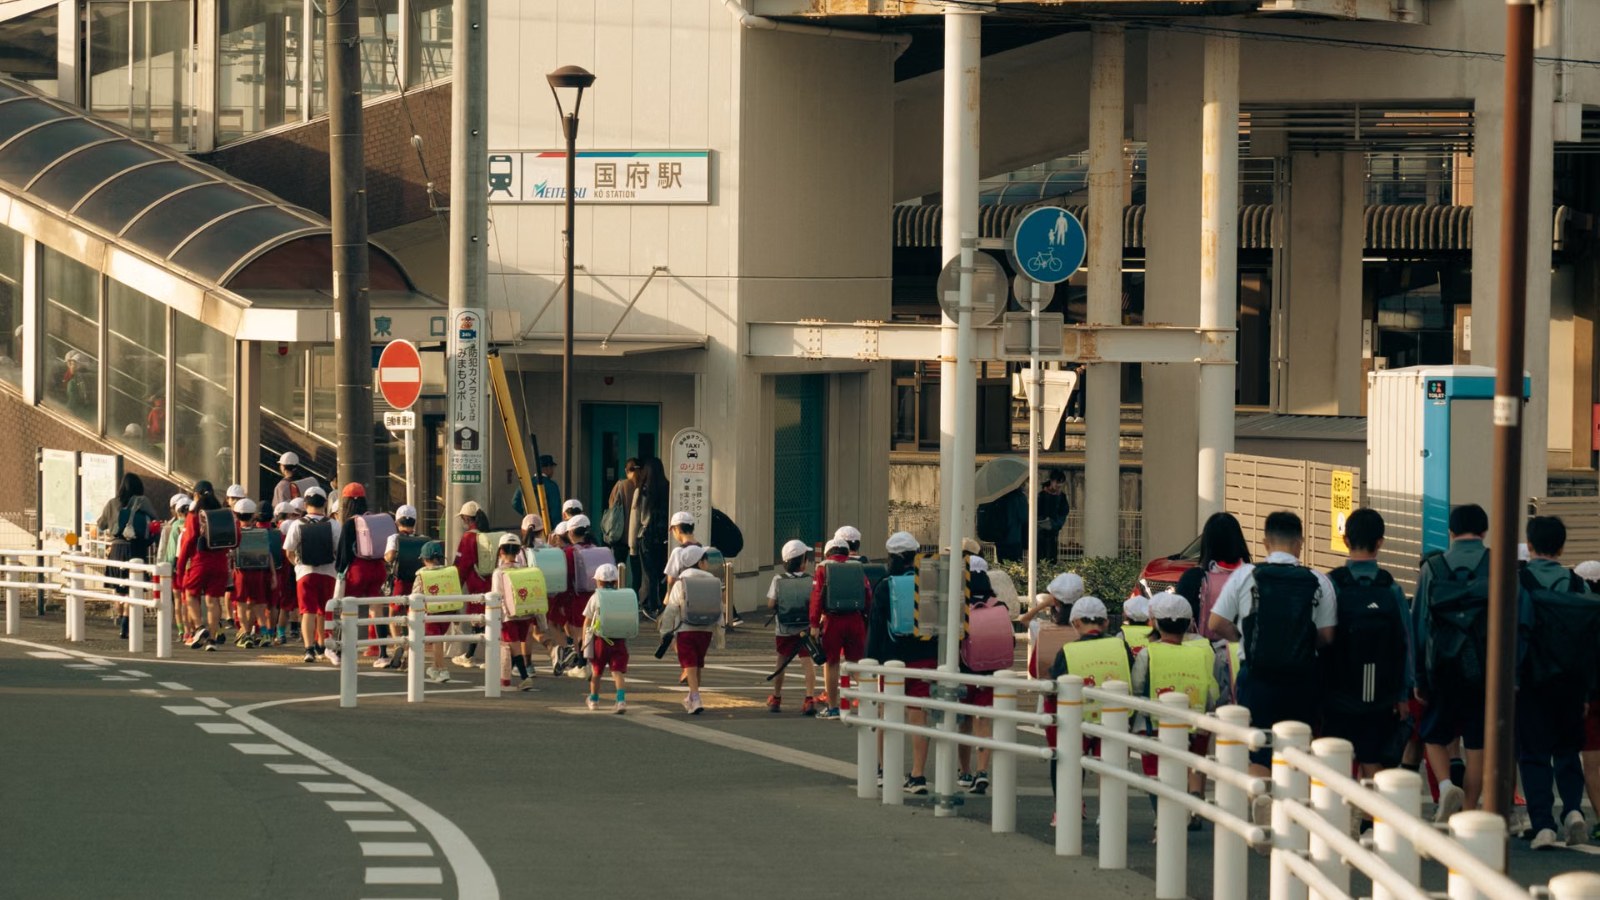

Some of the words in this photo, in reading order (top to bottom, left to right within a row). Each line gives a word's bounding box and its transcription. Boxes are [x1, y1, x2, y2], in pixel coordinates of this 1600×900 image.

[594, 161, 682, 189] 国府駅
[533, 180, 587, 198] MEITESU
[605, 190, 636, 198] STATION
[373, 316, 447, 337] 東口
[456, 347, 467, 422] みまもりポール
[468, 347, 478, 421] 防犯カメラといえば
[680, 463, 705, 471] のりば
